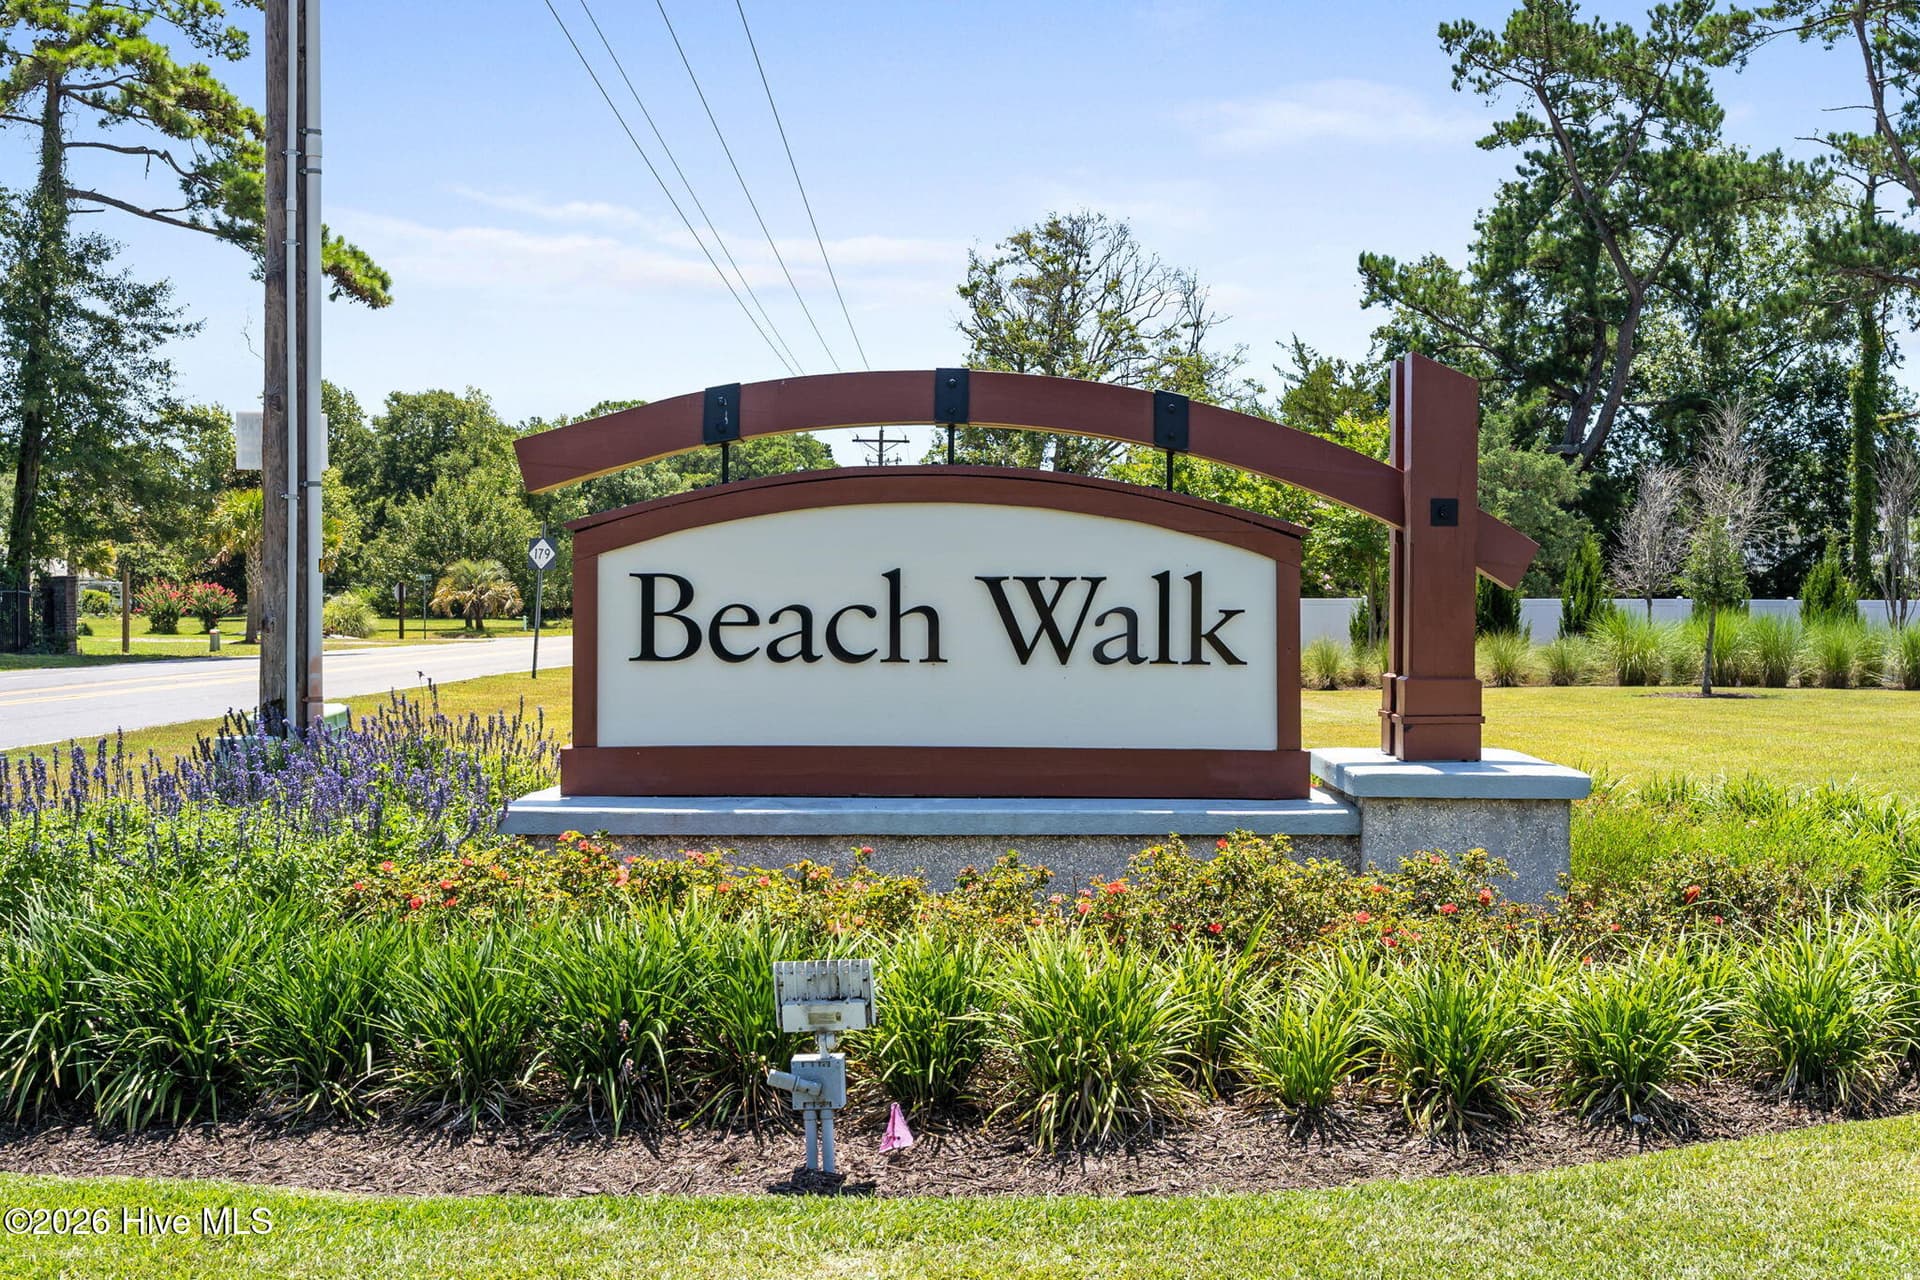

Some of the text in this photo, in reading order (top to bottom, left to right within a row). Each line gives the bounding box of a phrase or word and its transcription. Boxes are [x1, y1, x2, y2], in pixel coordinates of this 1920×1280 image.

[534, 548, 551, 560] 179
[629, 567, 1248, 667] Beach Walk
